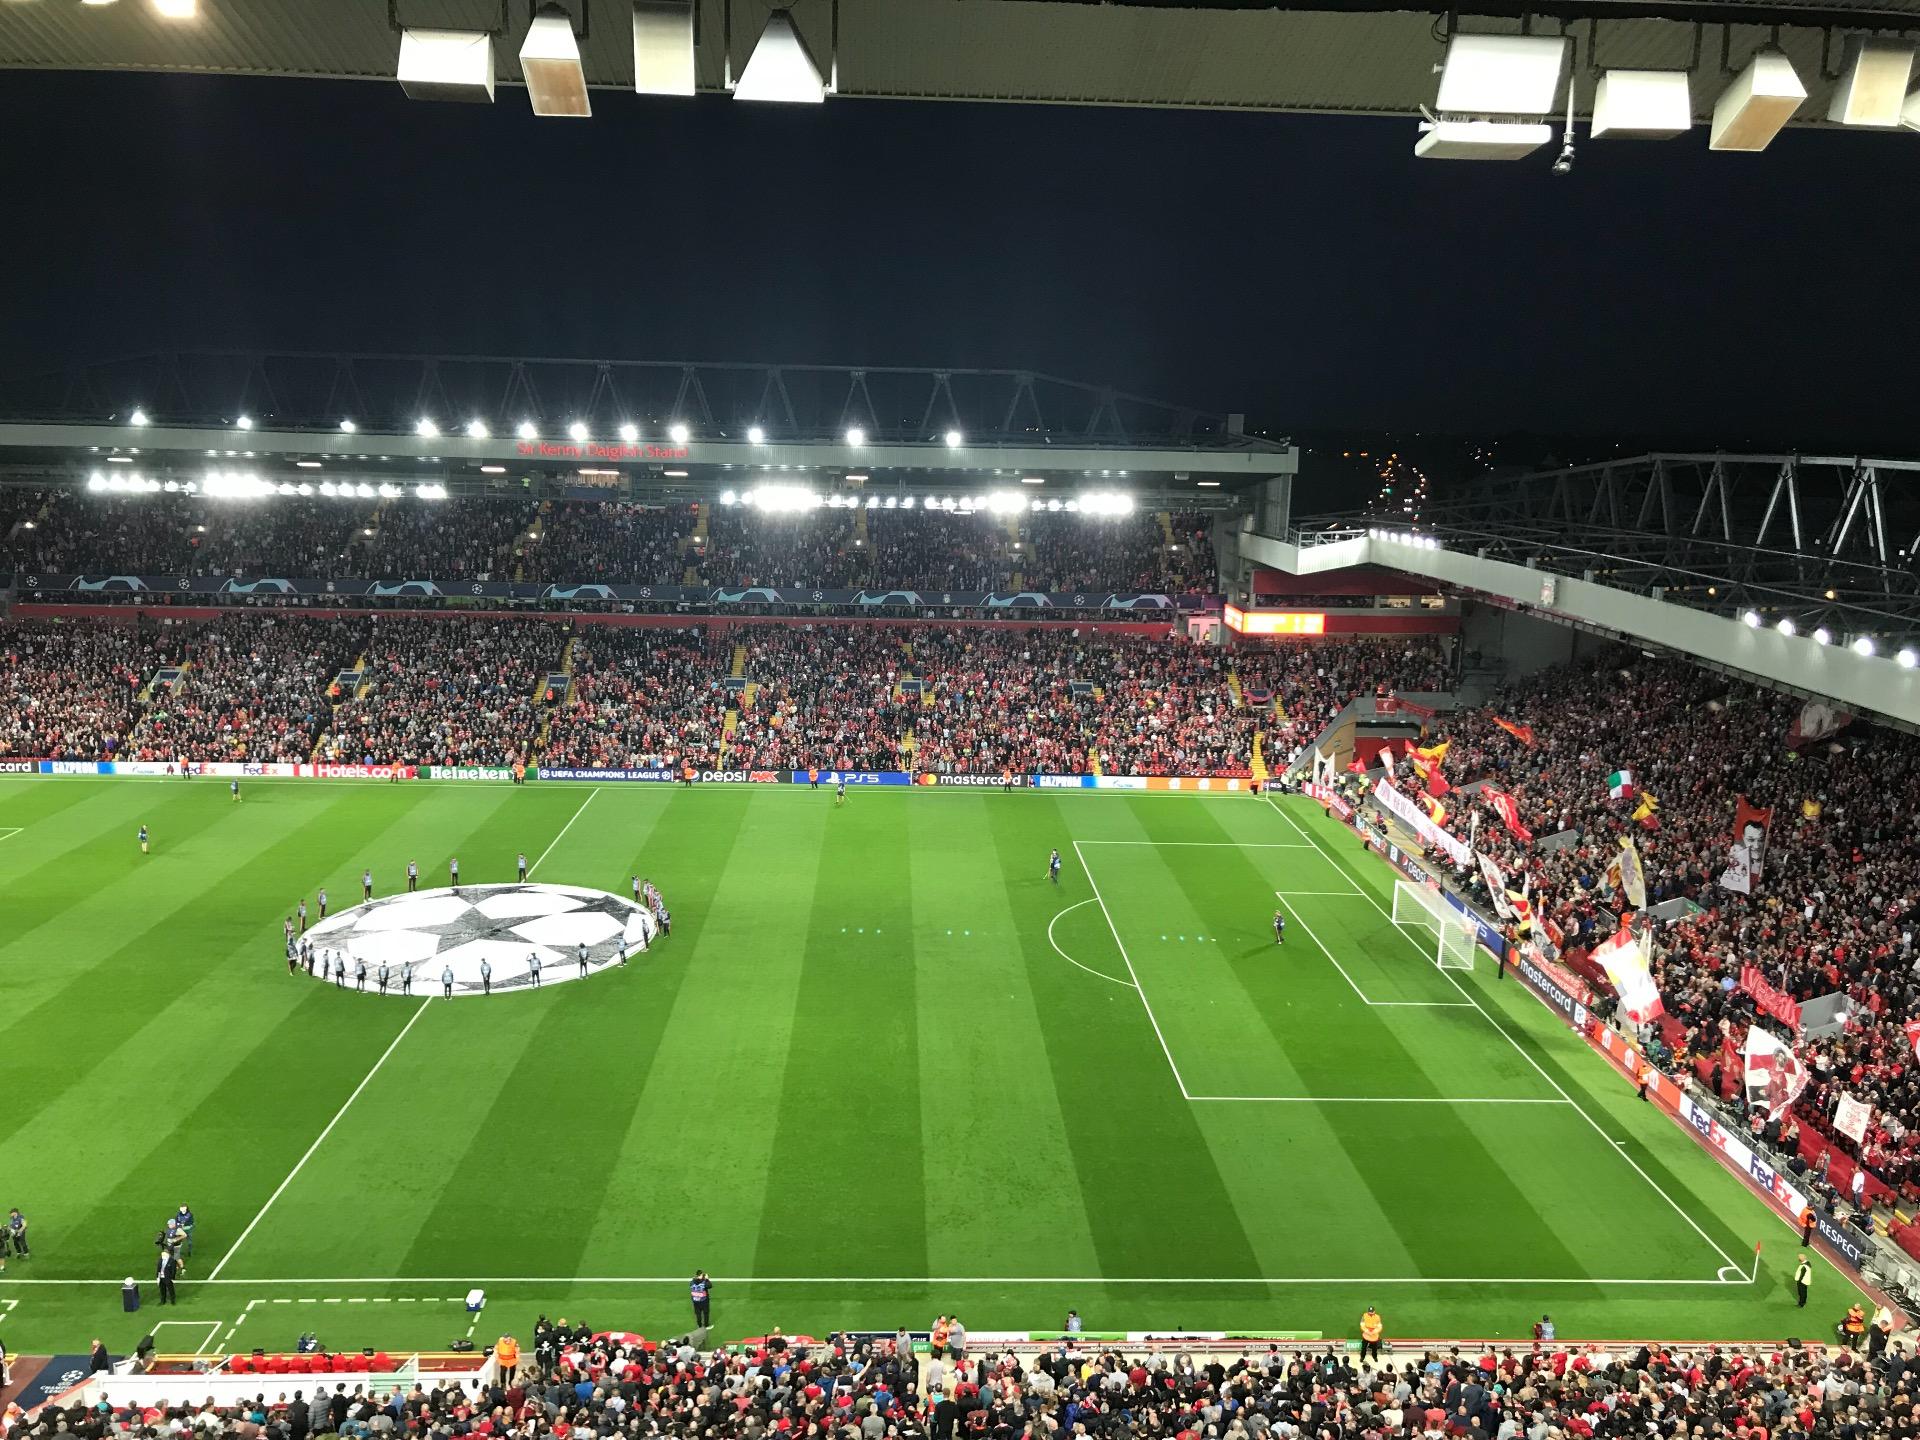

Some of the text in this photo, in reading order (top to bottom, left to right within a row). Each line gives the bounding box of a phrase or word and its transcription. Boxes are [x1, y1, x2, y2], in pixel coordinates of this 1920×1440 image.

[539, 443, 582, 458] Kenny
[645, 444, 688, 458] Stand
[243, 763, 278, 775] FedEx
[430, 766, 509, 780] Heineken
[551, 769, 660, 779] UEFA CHAMPIONS LEAGUE
[702, 770, 747, 782] pepsi
[844, 773, 880, 783] PS5
[1519, 958, 1572, 1012] mastercard
[1690, 1101, 1727, 1151] FedEx
[1750, 1153, 1793, 1208] FedEx
[1819, 1219, 1861, 1261] RESPECT
